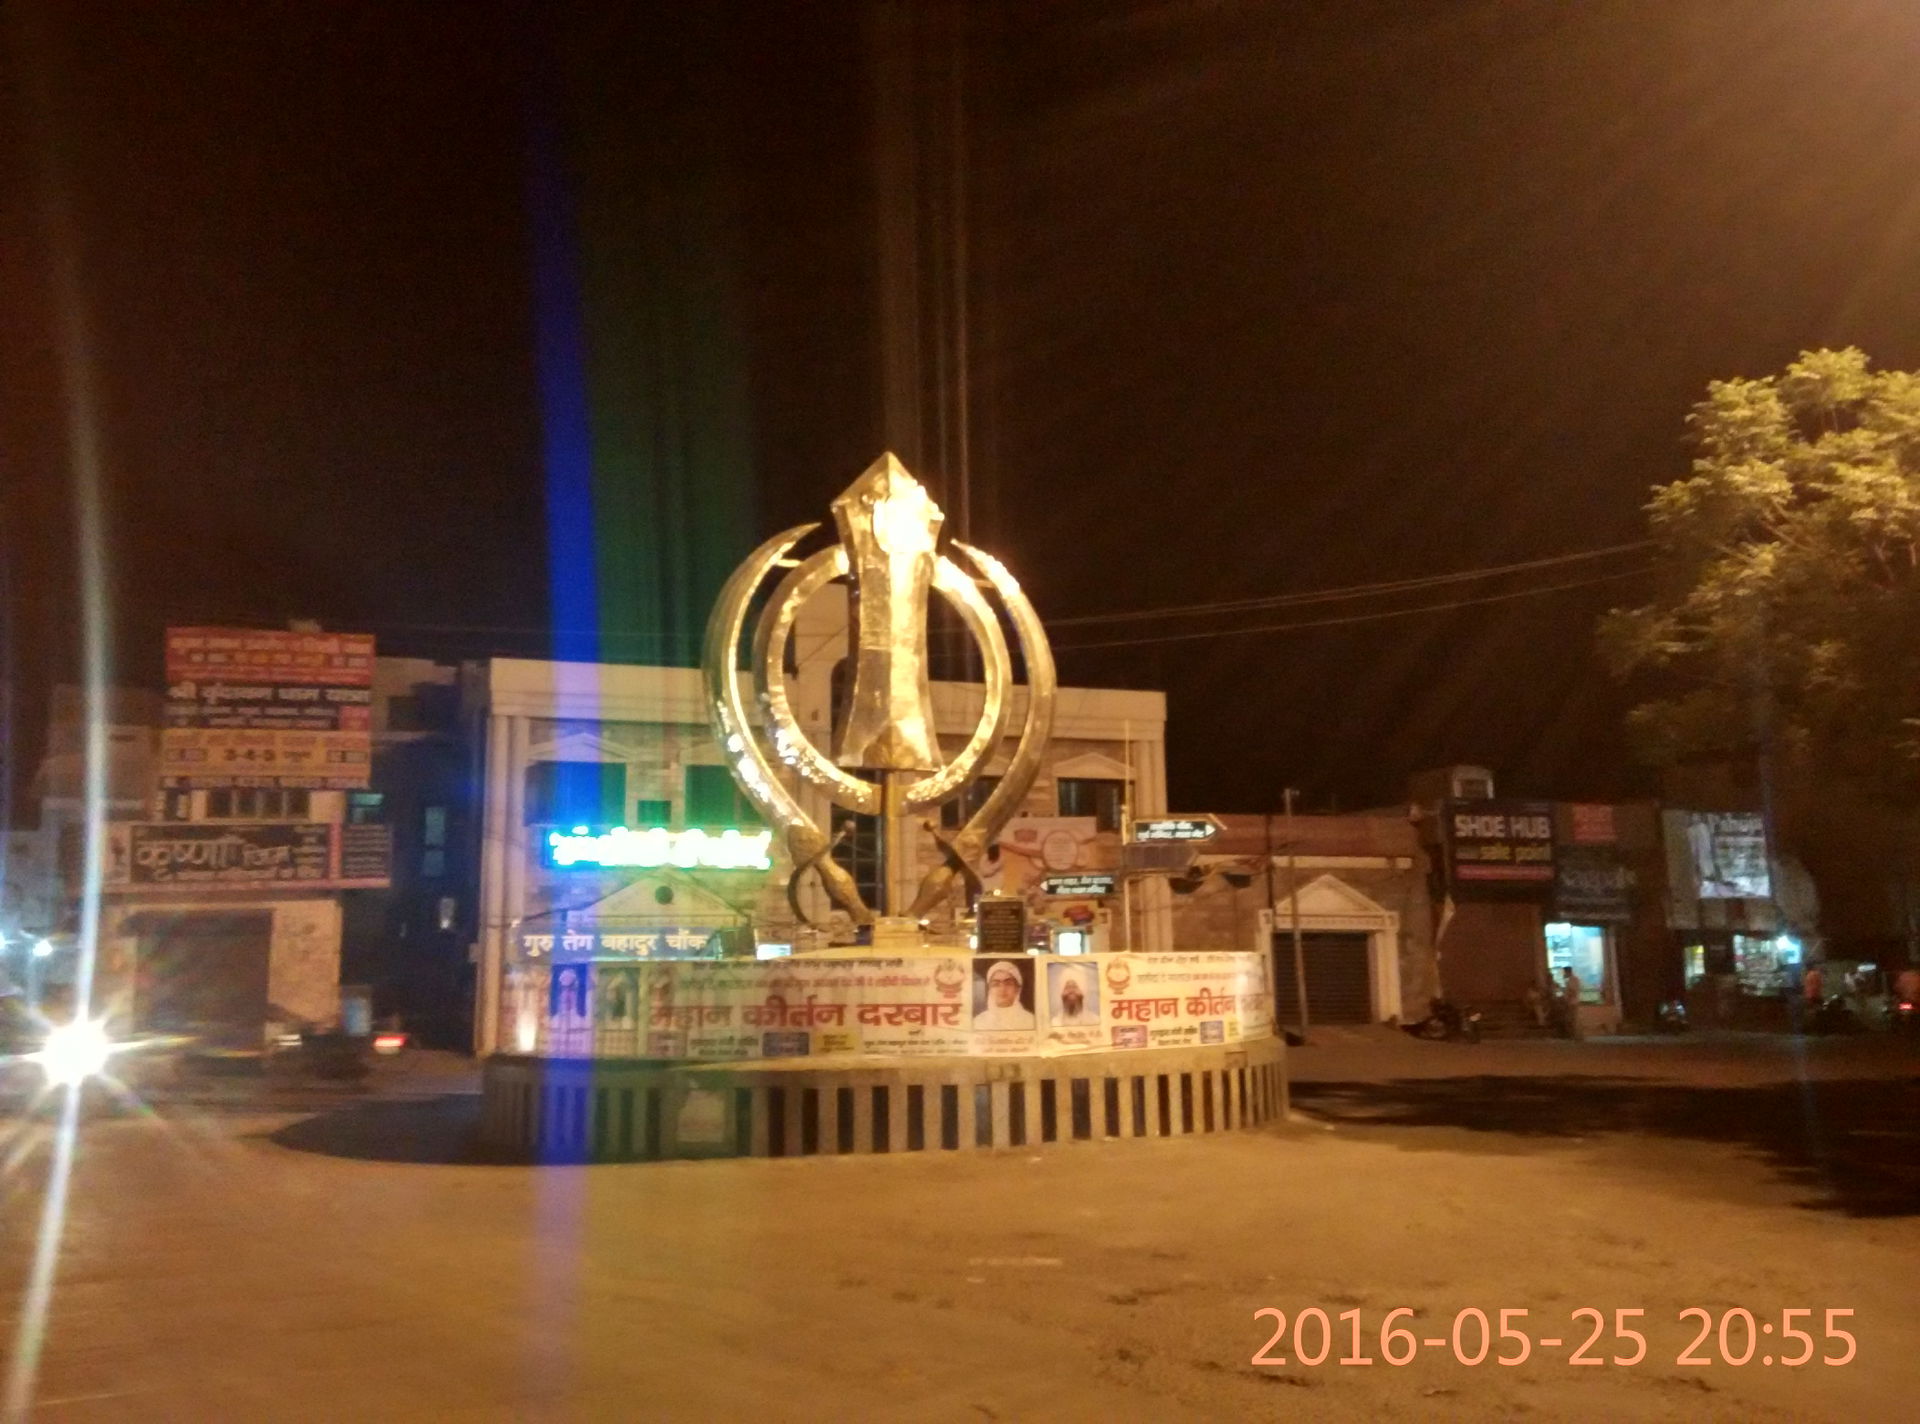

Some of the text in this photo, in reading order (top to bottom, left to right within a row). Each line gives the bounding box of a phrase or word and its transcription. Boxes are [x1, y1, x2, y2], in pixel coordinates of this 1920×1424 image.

[1455, 814, 1505, 838] SHOE
[1510, 816, 1551, 839] HUB
[523, 934, 555, 957] गुरु
[562, 929, 595, 951] तेग
[600, 934, 660, 956] बहादुर
[741, 994, 847, 1027] कीर्तन
[856, 1003, 963, 1027] दरबार
[1110, 997, 1180, 1022] महान
[1185, 987, 1237, 1016] कीर्तन
